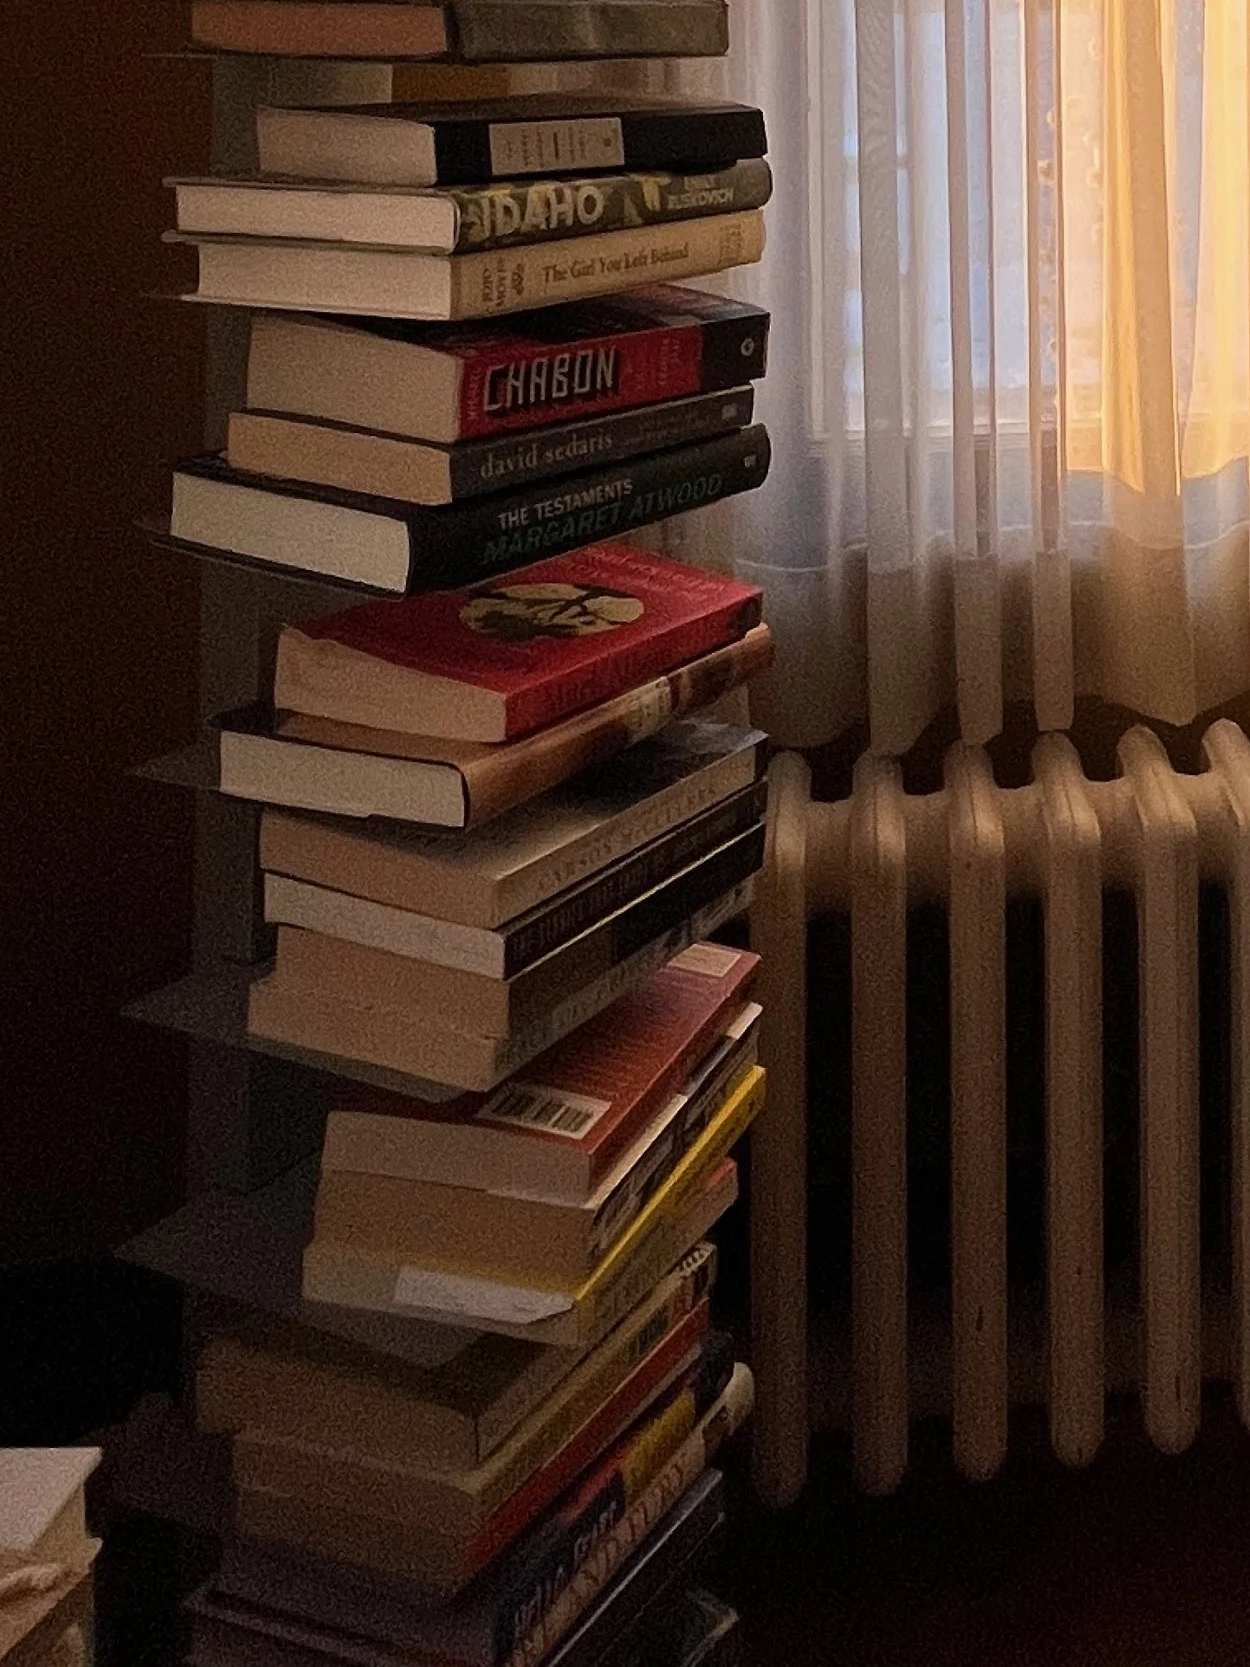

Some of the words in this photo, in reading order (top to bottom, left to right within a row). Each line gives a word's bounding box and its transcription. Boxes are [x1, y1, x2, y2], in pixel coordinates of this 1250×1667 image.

[482, 185, 604, 236] IDAHO
[544, 265, 567, 285] The
[599, 256, 620, 274] You
[484, 348, 616, 413] CHABON
[480, 441, 538, 480] david
[544, 428, 613, 464] sedaris
[480, 502, 622, 565] MARGARET
[629, 473, 723, 521] ATWOOD
[498, 509, 529, 531] THE
[535, 478, 635, 522] TESTAMENTS
